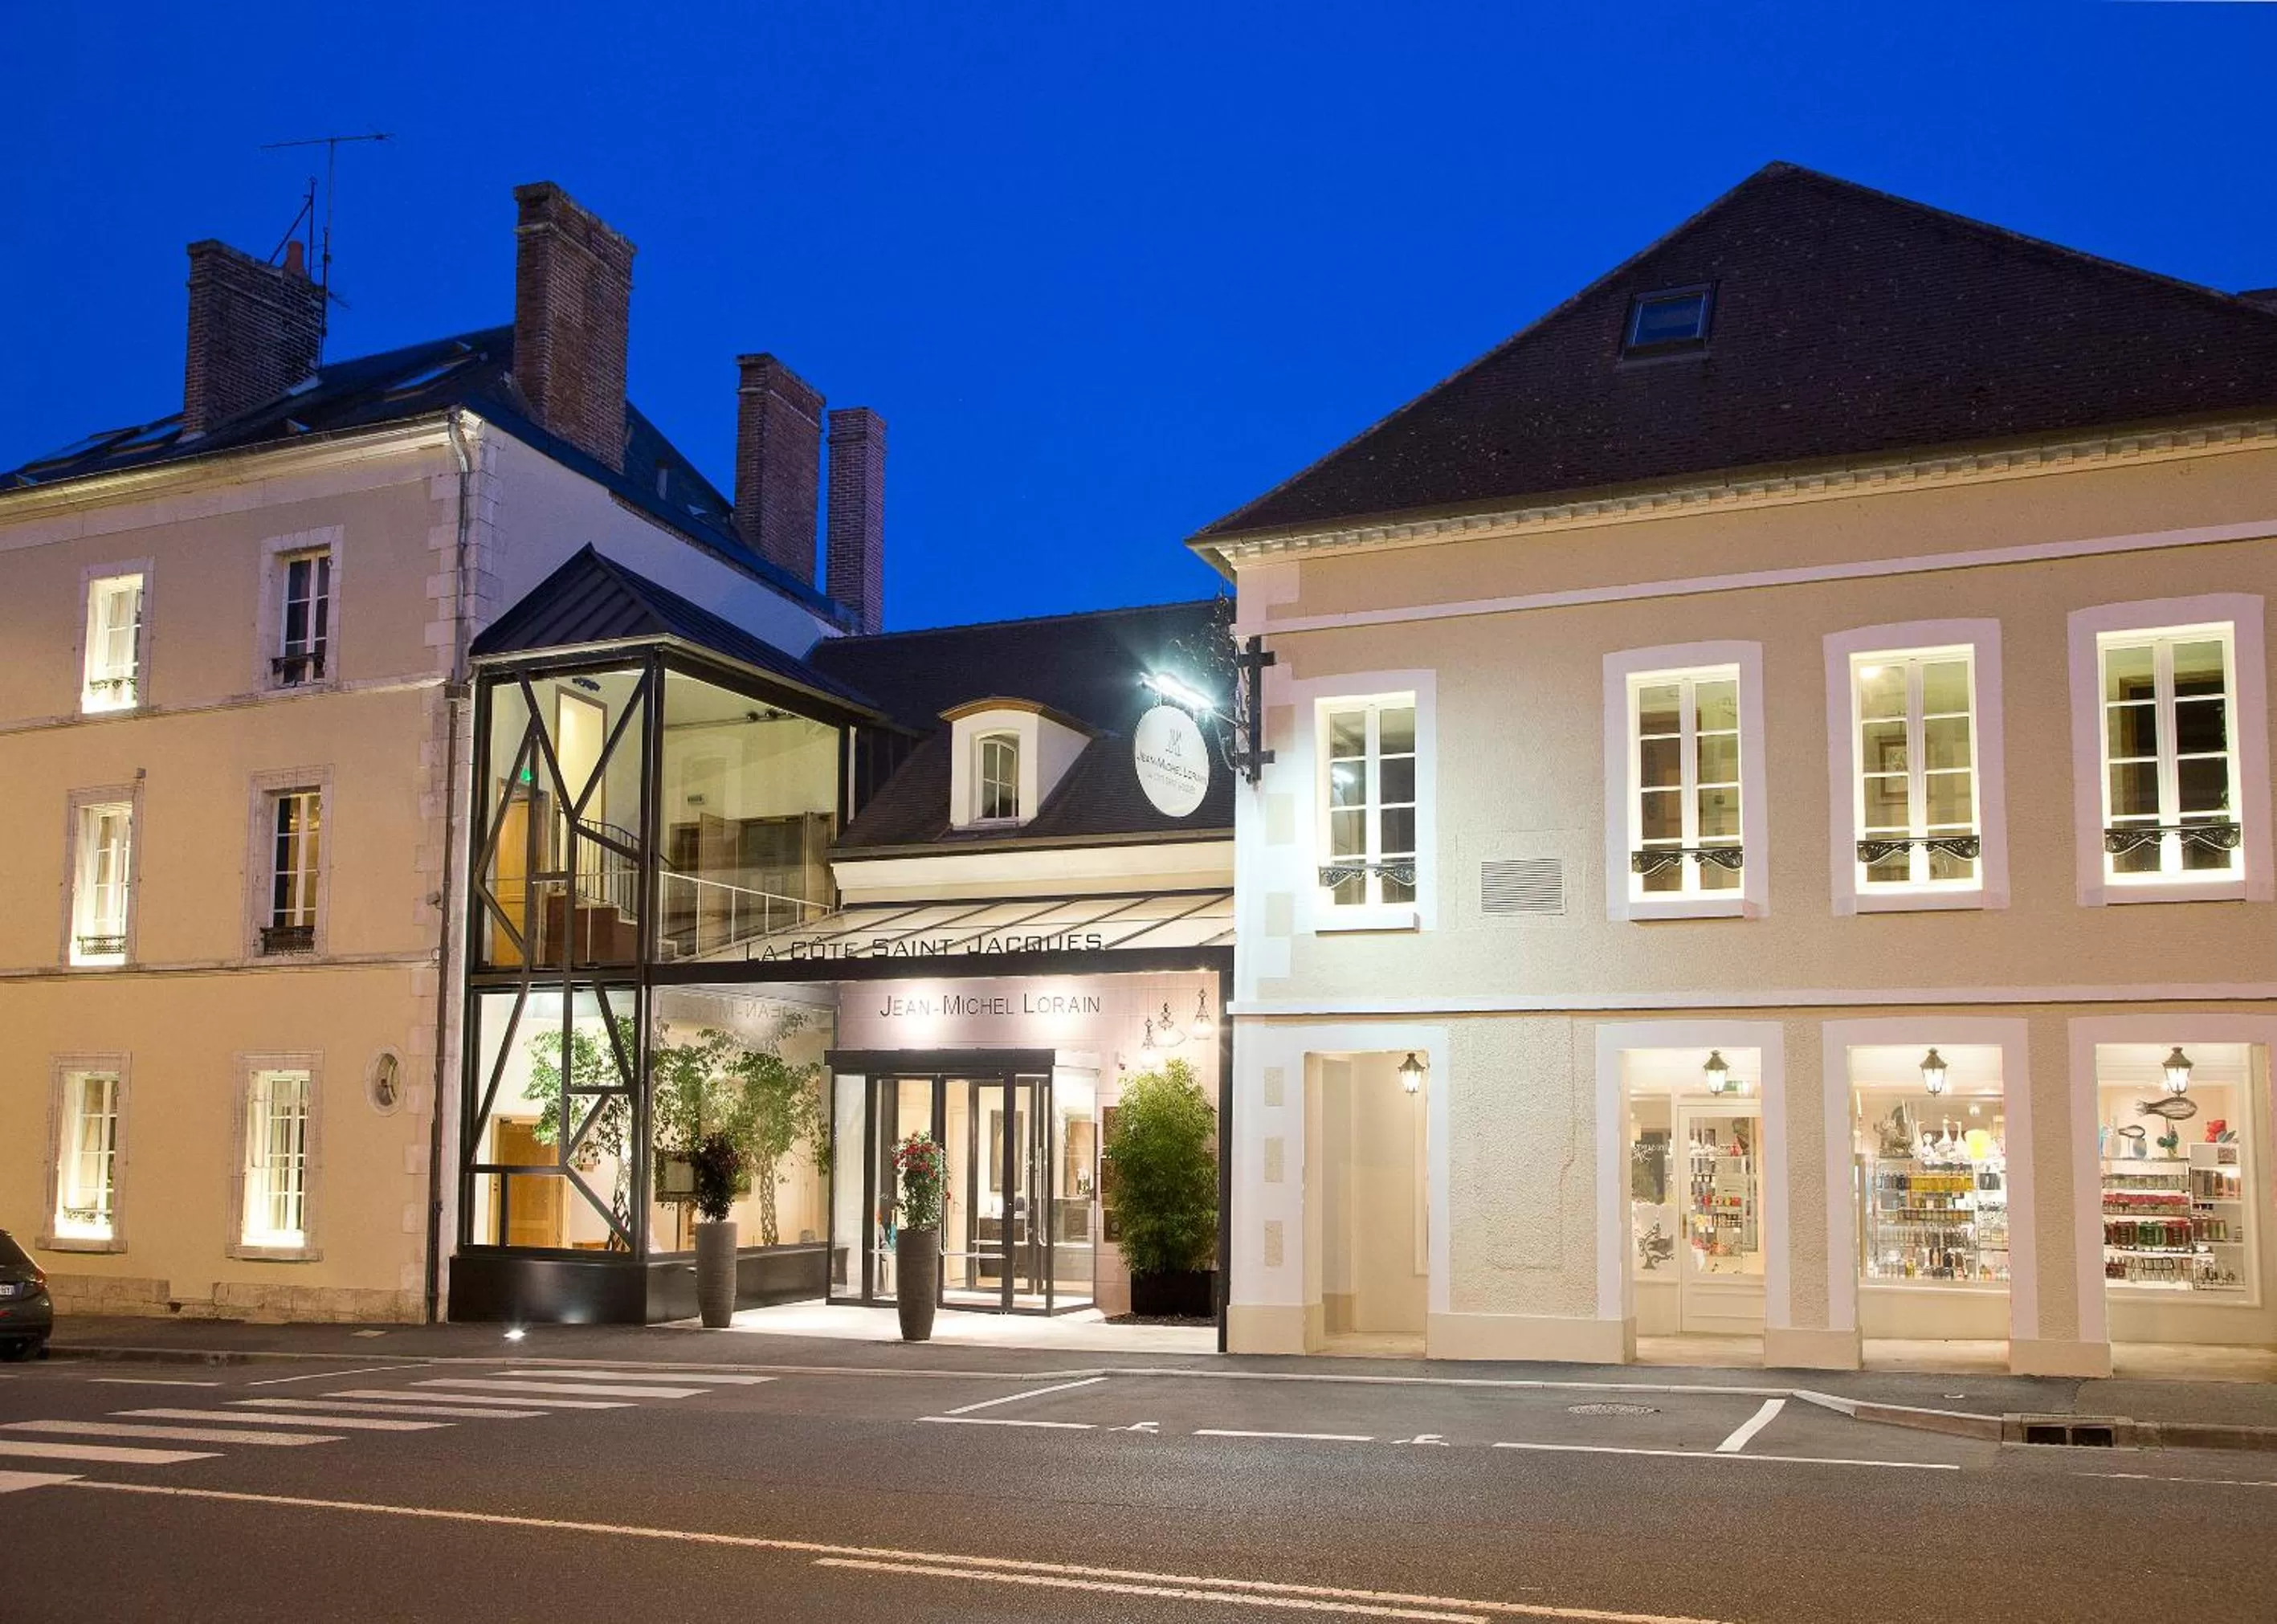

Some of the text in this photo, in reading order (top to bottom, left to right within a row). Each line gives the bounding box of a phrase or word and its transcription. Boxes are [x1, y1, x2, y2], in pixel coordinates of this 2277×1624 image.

[746, 933, 1102, 961] LA CÔTE SAINT JACQUES
[879, 993, 1100, 1017] JEAN-MICHEL LORAIN
